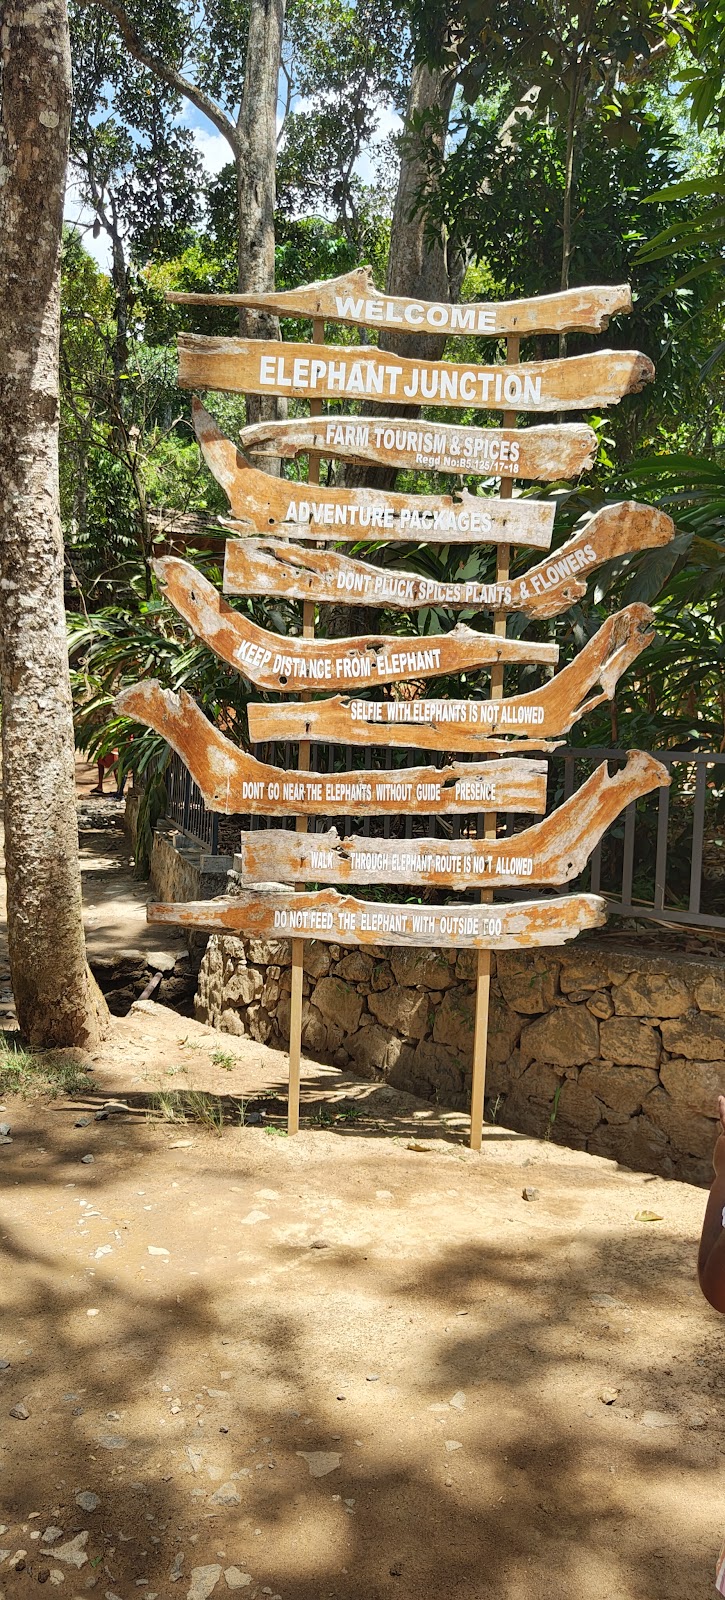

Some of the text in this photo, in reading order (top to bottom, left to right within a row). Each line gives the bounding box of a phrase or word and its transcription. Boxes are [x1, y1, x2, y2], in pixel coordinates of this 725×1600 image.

[336, 296, 497, 331] WELCOME
[259, 356, 541, 404] ELEPHANT JUNCTION
[326, 424, 520, 462] FARM TOURISM & SPICES
[415, 453, 441, 467] Regd
[285, 501, 493, 532] ADVENTURE PACKAGES
[336, 544, 597, 604] DONT PLUCK SPICES PLANTS & FLOWERS
[236, 639, 441, 679] KEEP DISTANCE FROM ELEPHANT
[351, 702, 545, 724] SELFIE WITH ELEPHANTS IS NOT ALLOWED
[242, 781, 496, 801] DONT GO NEAR THE ELEPHANTS WITHOUT GUIDE PRESENCE
[311, 851, 333, 869] WALK
[350, 852, 388, 870] THROUGH
[391, 853, 433, 872] ELEPHANT
[435, 855, 461, 873] ROUTE
[463, 855, 472, 873] IS
[496, 857, 533, 875] ALLOWED
[274, 910, 287, 928] DO
[289, 911, 308, 929] NOT
[309, 911, 333, 929] FEED
[337, 912, 356, 930] THE
[360, 913, 408, 932] ELEPHANT
[412, 915, 435, 933] WITH
[440, 916, 479, 934] OUTSIDE
